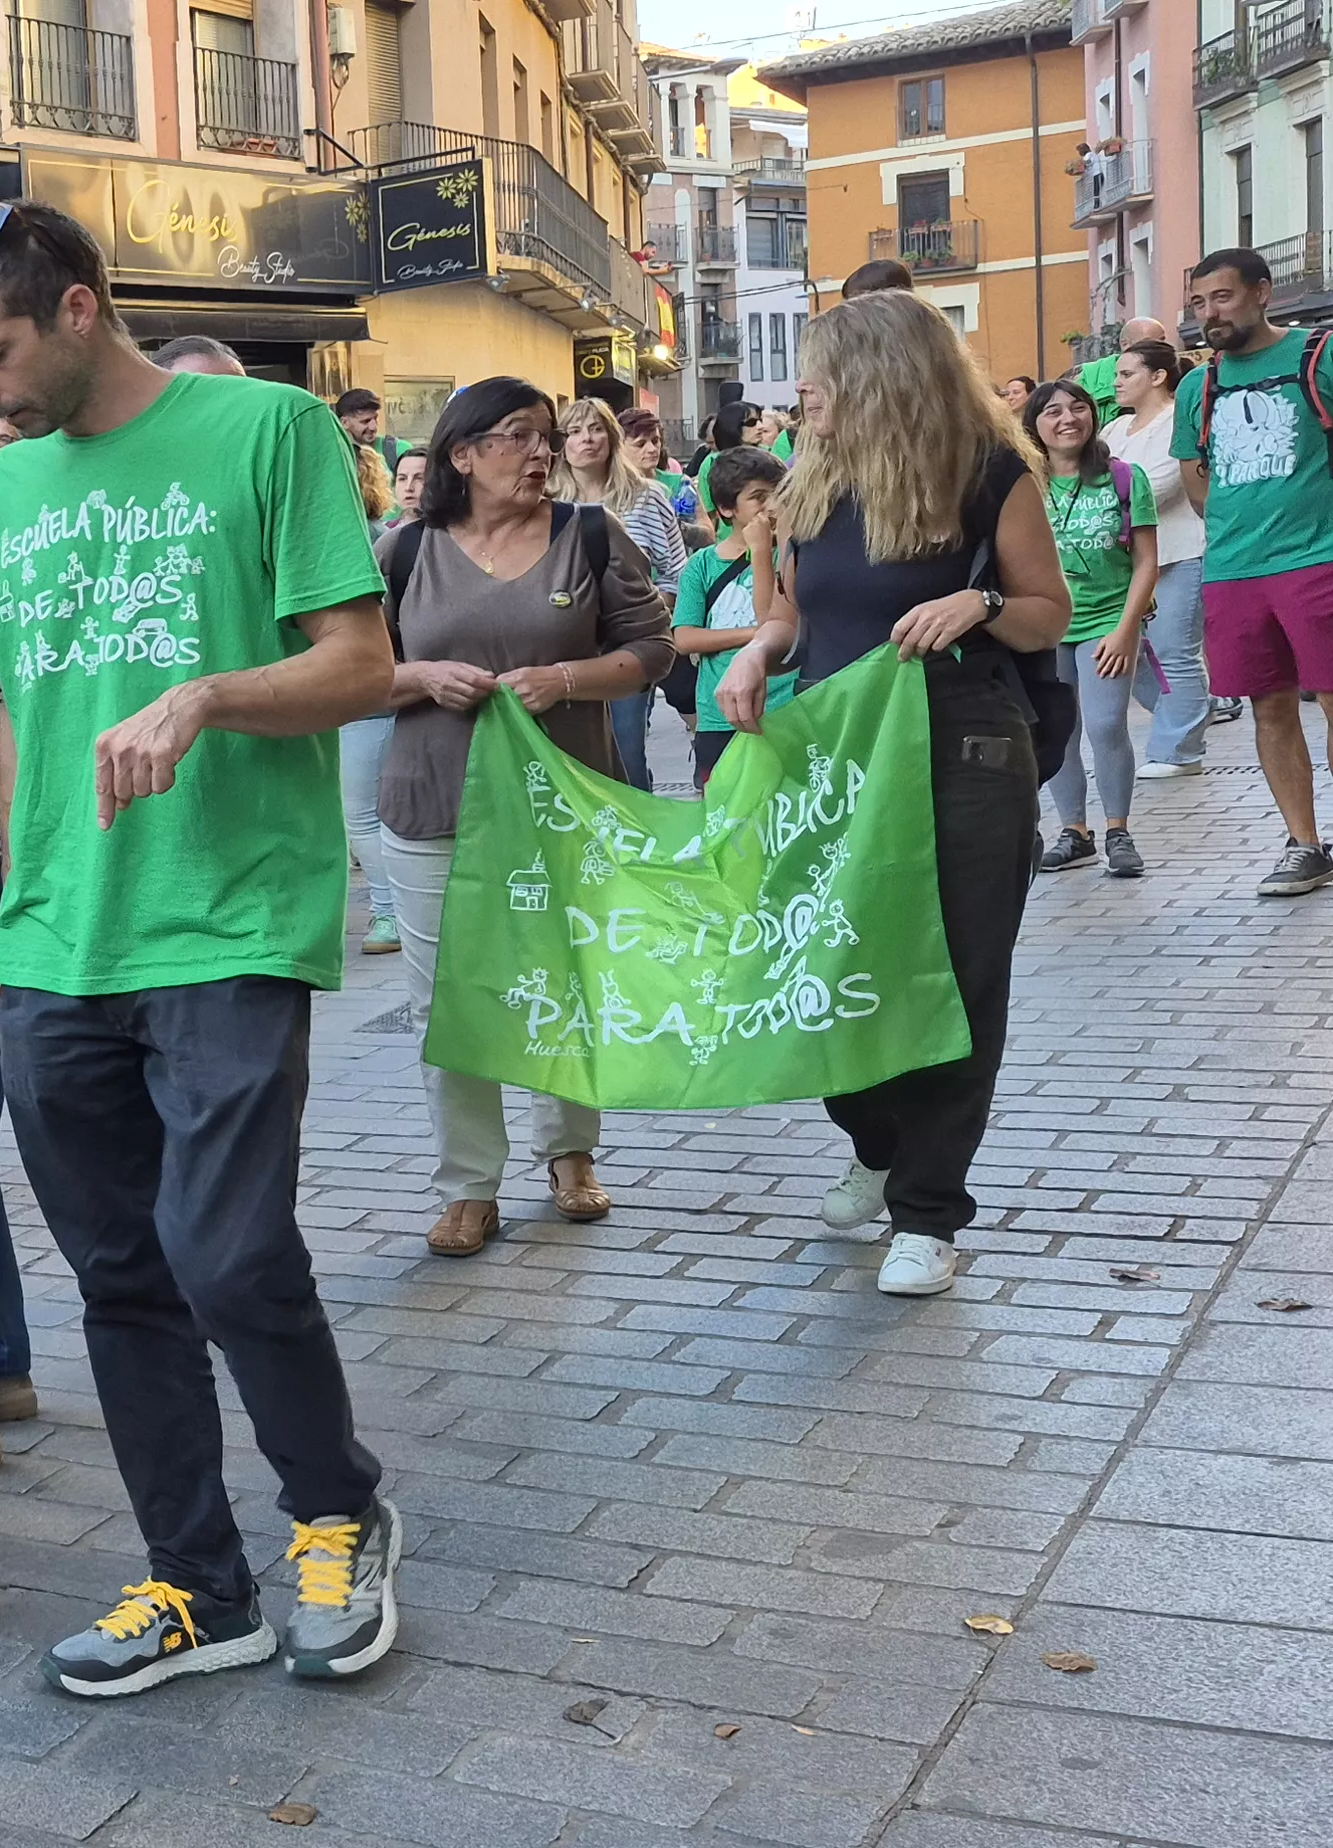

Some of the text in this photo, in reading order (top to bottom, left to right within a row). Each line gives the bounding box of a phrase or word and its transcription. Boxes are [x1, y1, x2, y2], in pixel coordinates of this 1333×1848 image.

[217, 245, 262, 283] Beauty
[263, 251, 295, 284] Studio
[0, 495, 218, 569] ESCUELA PÚBLICA:
[19, 572, 183, 628] DE TOD@S
[94, 633, 201, 668] TOD@S
[565, 906, 646, 954] DE
[525, 972, 881, 1047] PARA TOD@S
[524, 1040, 591, 1058] Huesca
